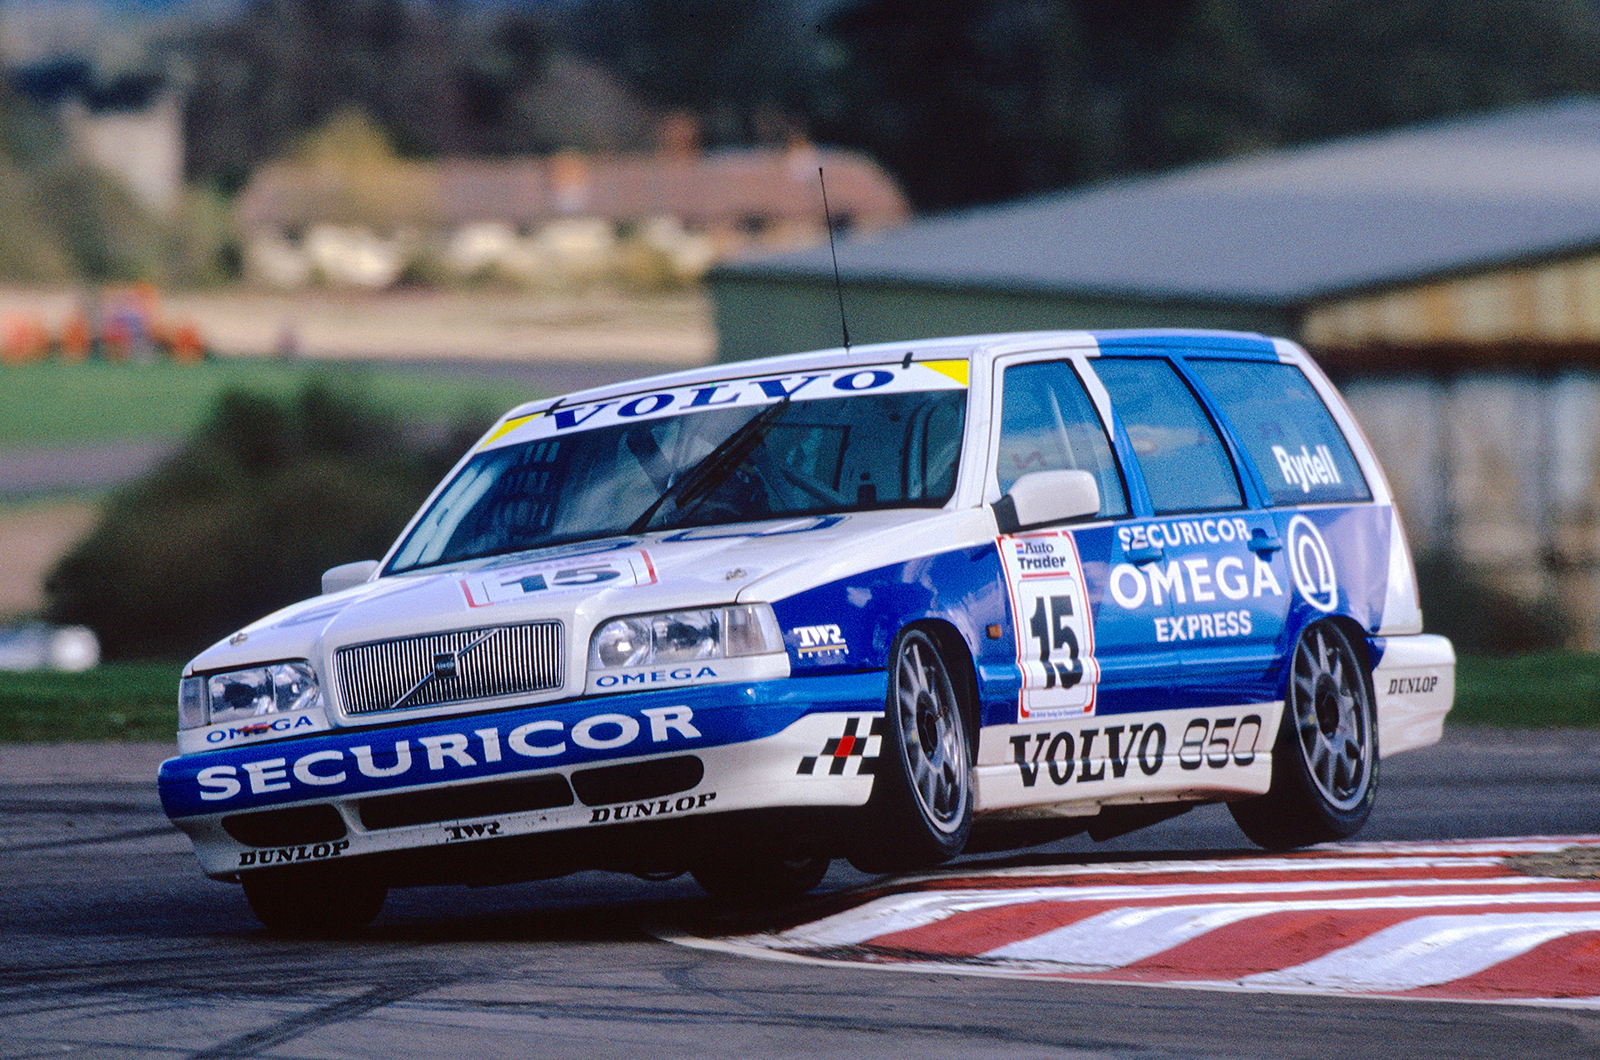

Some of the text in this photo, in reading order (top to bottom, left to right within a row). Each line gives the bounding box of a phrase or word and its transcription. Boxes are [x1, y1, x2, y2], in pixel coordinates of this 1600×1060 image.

[551, 370, 895, 430] VOLVO
[1272, 444, 1341, 493] Rydell
[1024, 542, 1054, 554] Auto
[1118, 518, 1252, 551] SECURICOR
[1018, 556, 1066, 569] Trader
[500, 564, 621, 593] 15
[1110, 557, 1282, 608] OMEGA
[793, 624, 846, 647] TWR
[1030, 595, 1083, 688] 15
[1154, 610, 1252, 642] EXPRESS
[596, 667, 718, 687] OMEGA
[1388, 677, 1438, 694] DUNLOP
[197, 705, 702, 800] SECURICOR
[1010, 715, 1262, 787] VOLVO 850
[590, 792, 717, 823] DUNLOP
[239, 841, 349, 866] DUNLOP
